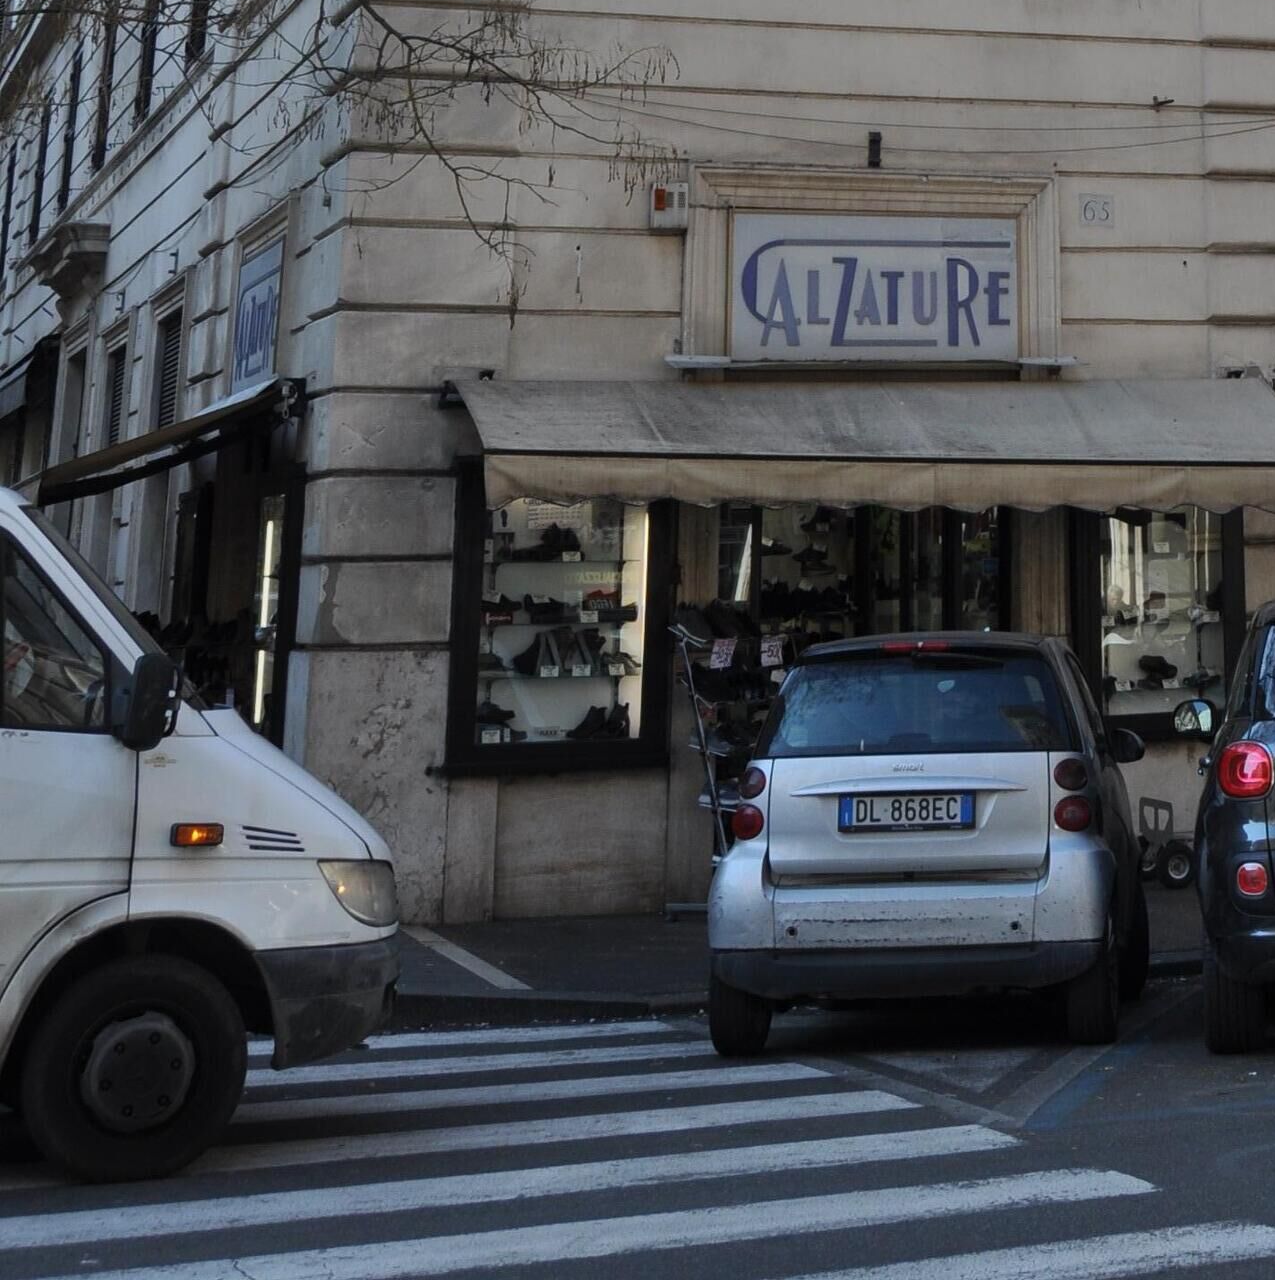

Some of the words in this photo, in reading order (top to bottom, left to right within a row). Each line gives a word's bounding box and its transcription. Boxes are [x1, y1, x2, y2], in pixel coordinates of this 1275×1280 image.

[1083, 199, 1109, 221] 65
[741, 238, 1011, 347] CALZATURE
[856, 799, 881, 823] DL
[891, 797, 958, 822] 868EC
